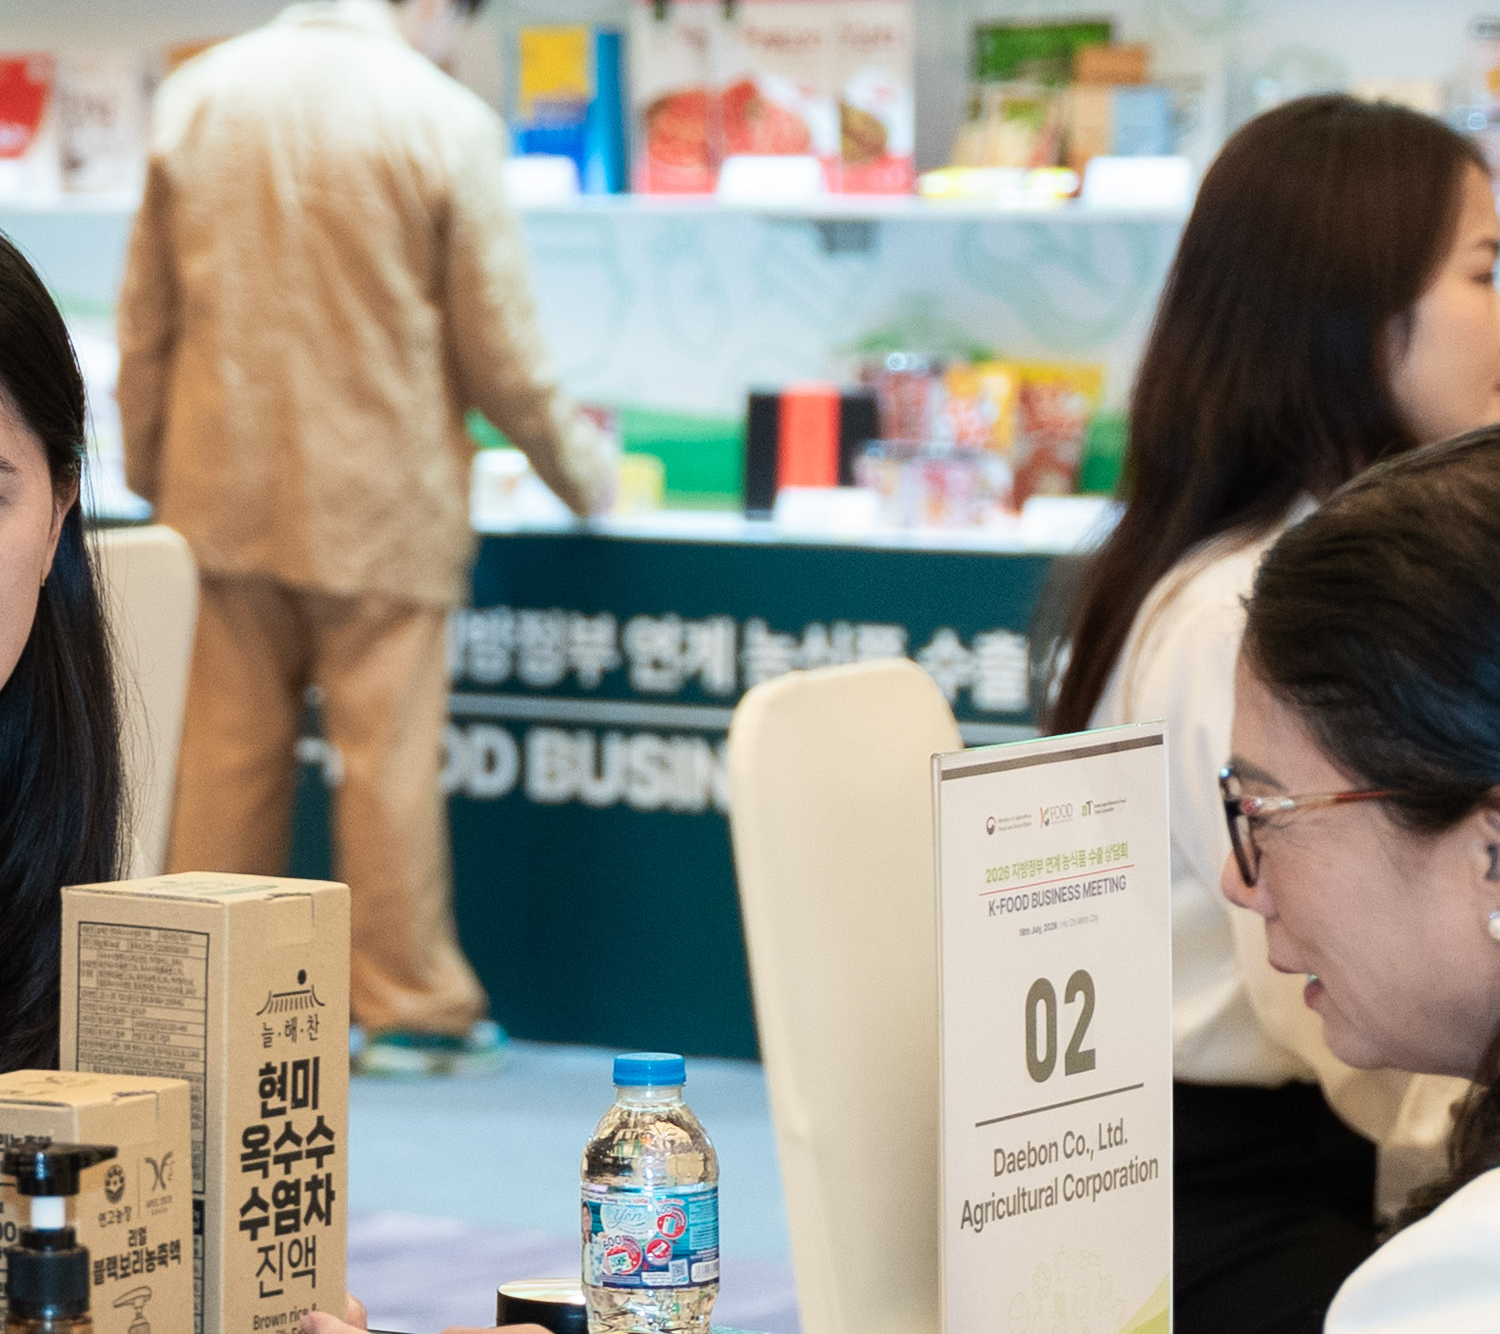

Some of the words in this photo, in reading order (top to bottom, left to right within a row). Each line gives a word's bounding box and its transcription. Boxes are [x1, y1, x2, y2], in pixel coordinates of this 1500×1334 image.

[985, 865, 1010, 884] 2026
[988, 894, 1029, 917] K-FOOD
[1031, 884, 1081, 909] BUSINESS
[1082, 875, 1126, 899] MEETING
[1025, 969, 1096, 1083] 02
[258, 1056, 320, 1119] 현미
[240, 1115, 336, 1180] 옥수수
[993, 1140, 1058, 1177] Daebon
[1063, 1130, 1094, 1161] Co.,
[1098, 1117, 1128, 1151] Ltd.
[238, 1172, 336, 1242] 수염차
[960, 1177, 1058, 1233] Agricultural
[1062, 1154, 1159, 1203] Corporation
[255, 1234, 317, 1299] 진액
[253, 1313, 287, 1331] Brown
